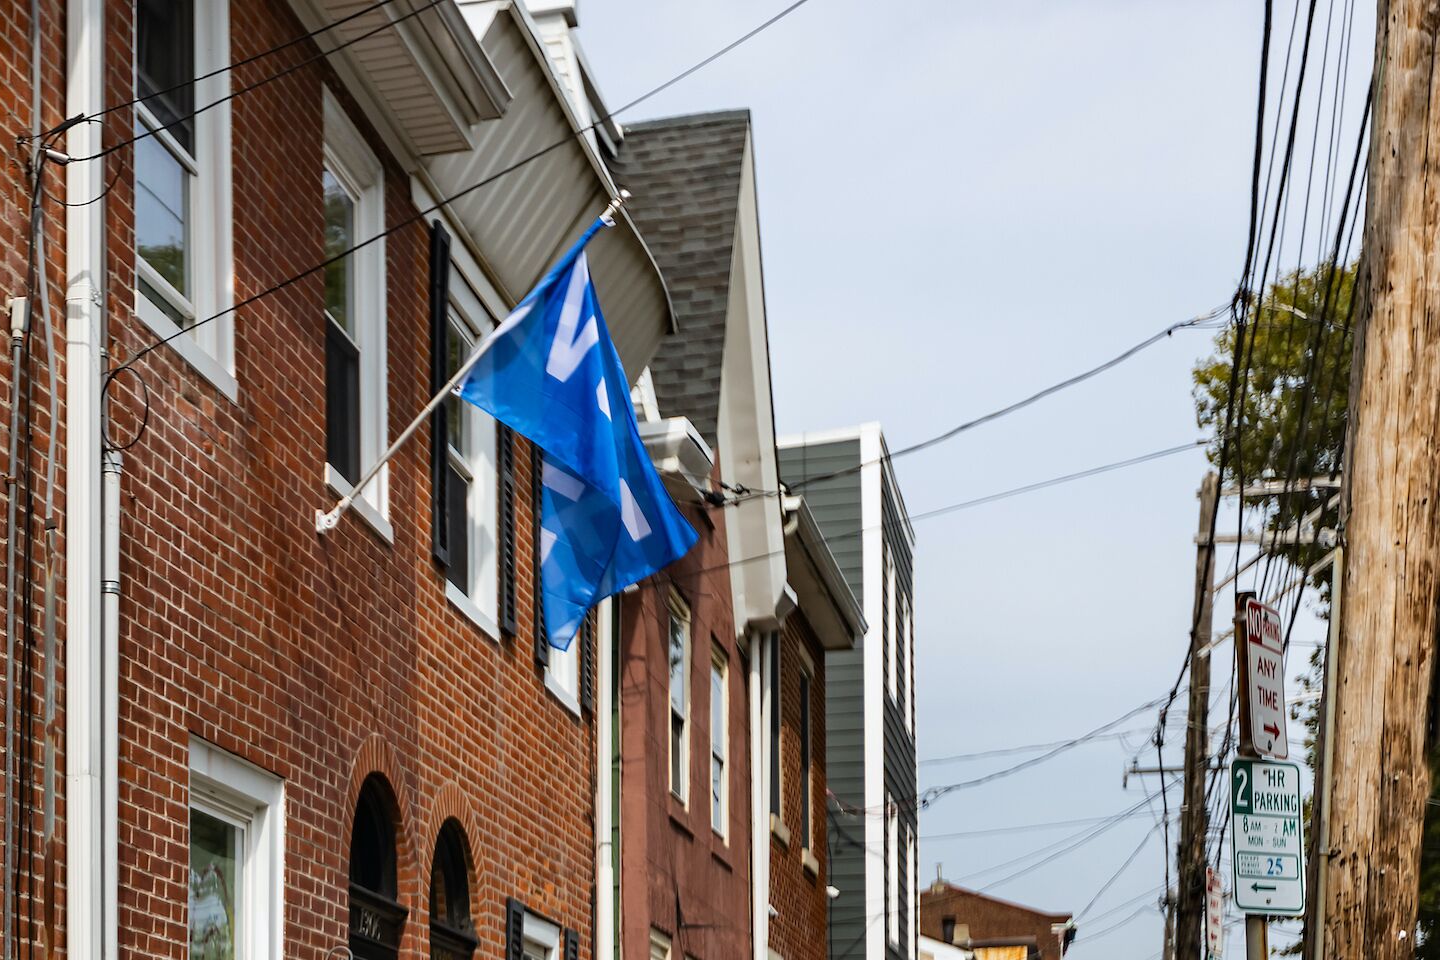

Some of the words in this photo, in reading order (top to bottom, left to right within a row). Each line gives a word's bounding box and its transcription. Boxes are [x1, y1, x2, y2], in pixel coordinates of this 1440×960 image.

[1249, 607, 1261, 638] NO
[1257, 656, 1277, 680] ANY
[1257, 685, 1278, 712] TIME
[1235, 767, 1248, 807] 2
[1268, 768, 1285, 788] HR
[1254, 791, 1297, 813] PARKING
[1242, 814, 1249, 834] 8
[1250, 821, 1262, 832] AM
[1282, 816, 1297, 837] AM
[1247, 835, 1264, 847] MON
[1272, 837, 1287, 848] SUN
[1267, 857, 1283, 875] 25
